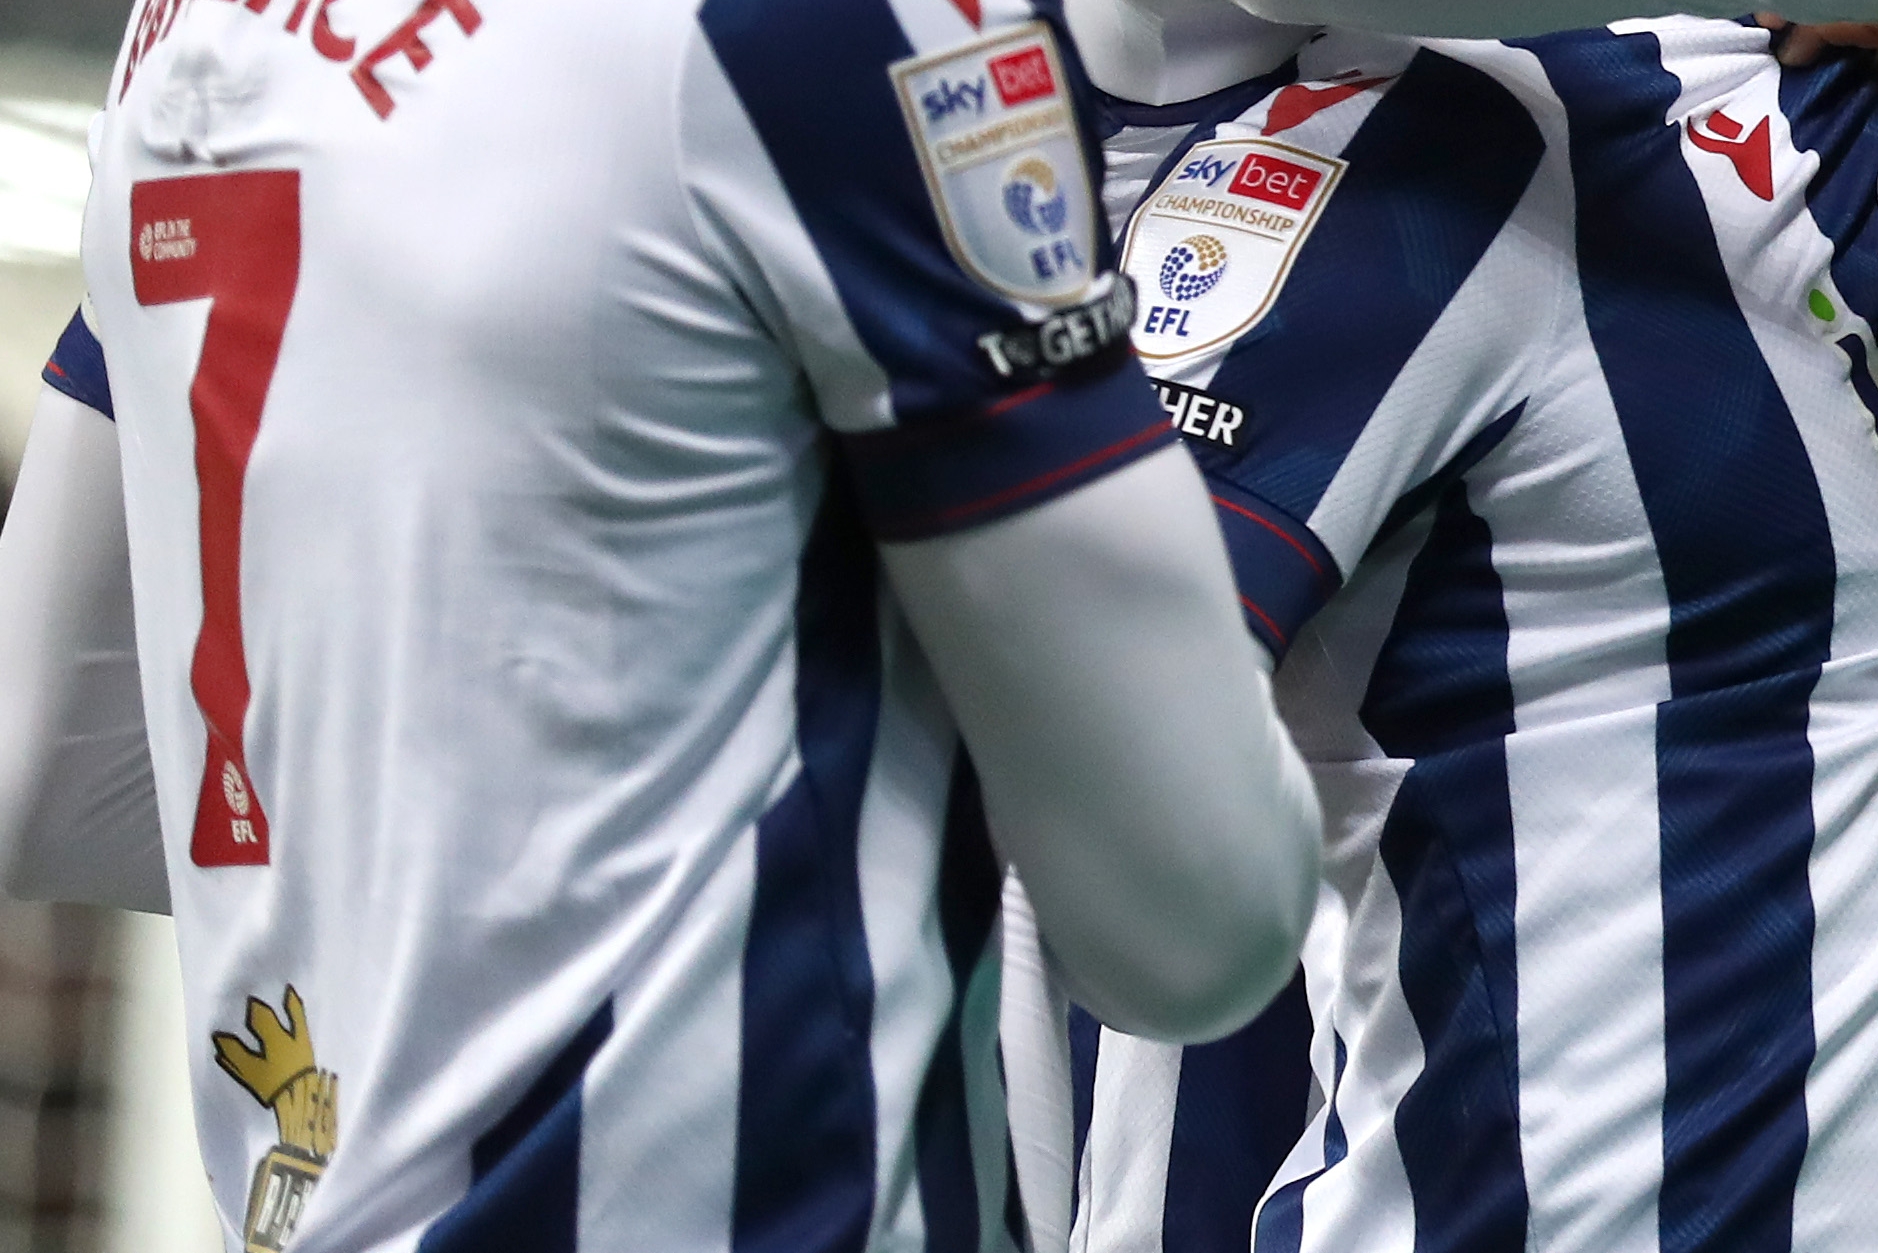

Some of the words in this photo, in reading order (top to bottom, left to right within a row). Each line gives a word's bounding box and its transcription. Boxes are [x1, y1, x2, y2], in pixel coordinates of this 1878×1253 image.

[921, 75, 986, 122] sky
[1176, 154, 1237, 188] sky
[1239, 158, 1308, 199] bet
[1154, 194, 1294, 232] CHAMPIONSHIP
[1032, 239, 1084, 279] EFL
[1144, 305, 1191, 337] EFL
[1151, 381, 1243, 447] HER
[130, 169, 301, 866] 7
[231, 819, 258, 843] EFL
